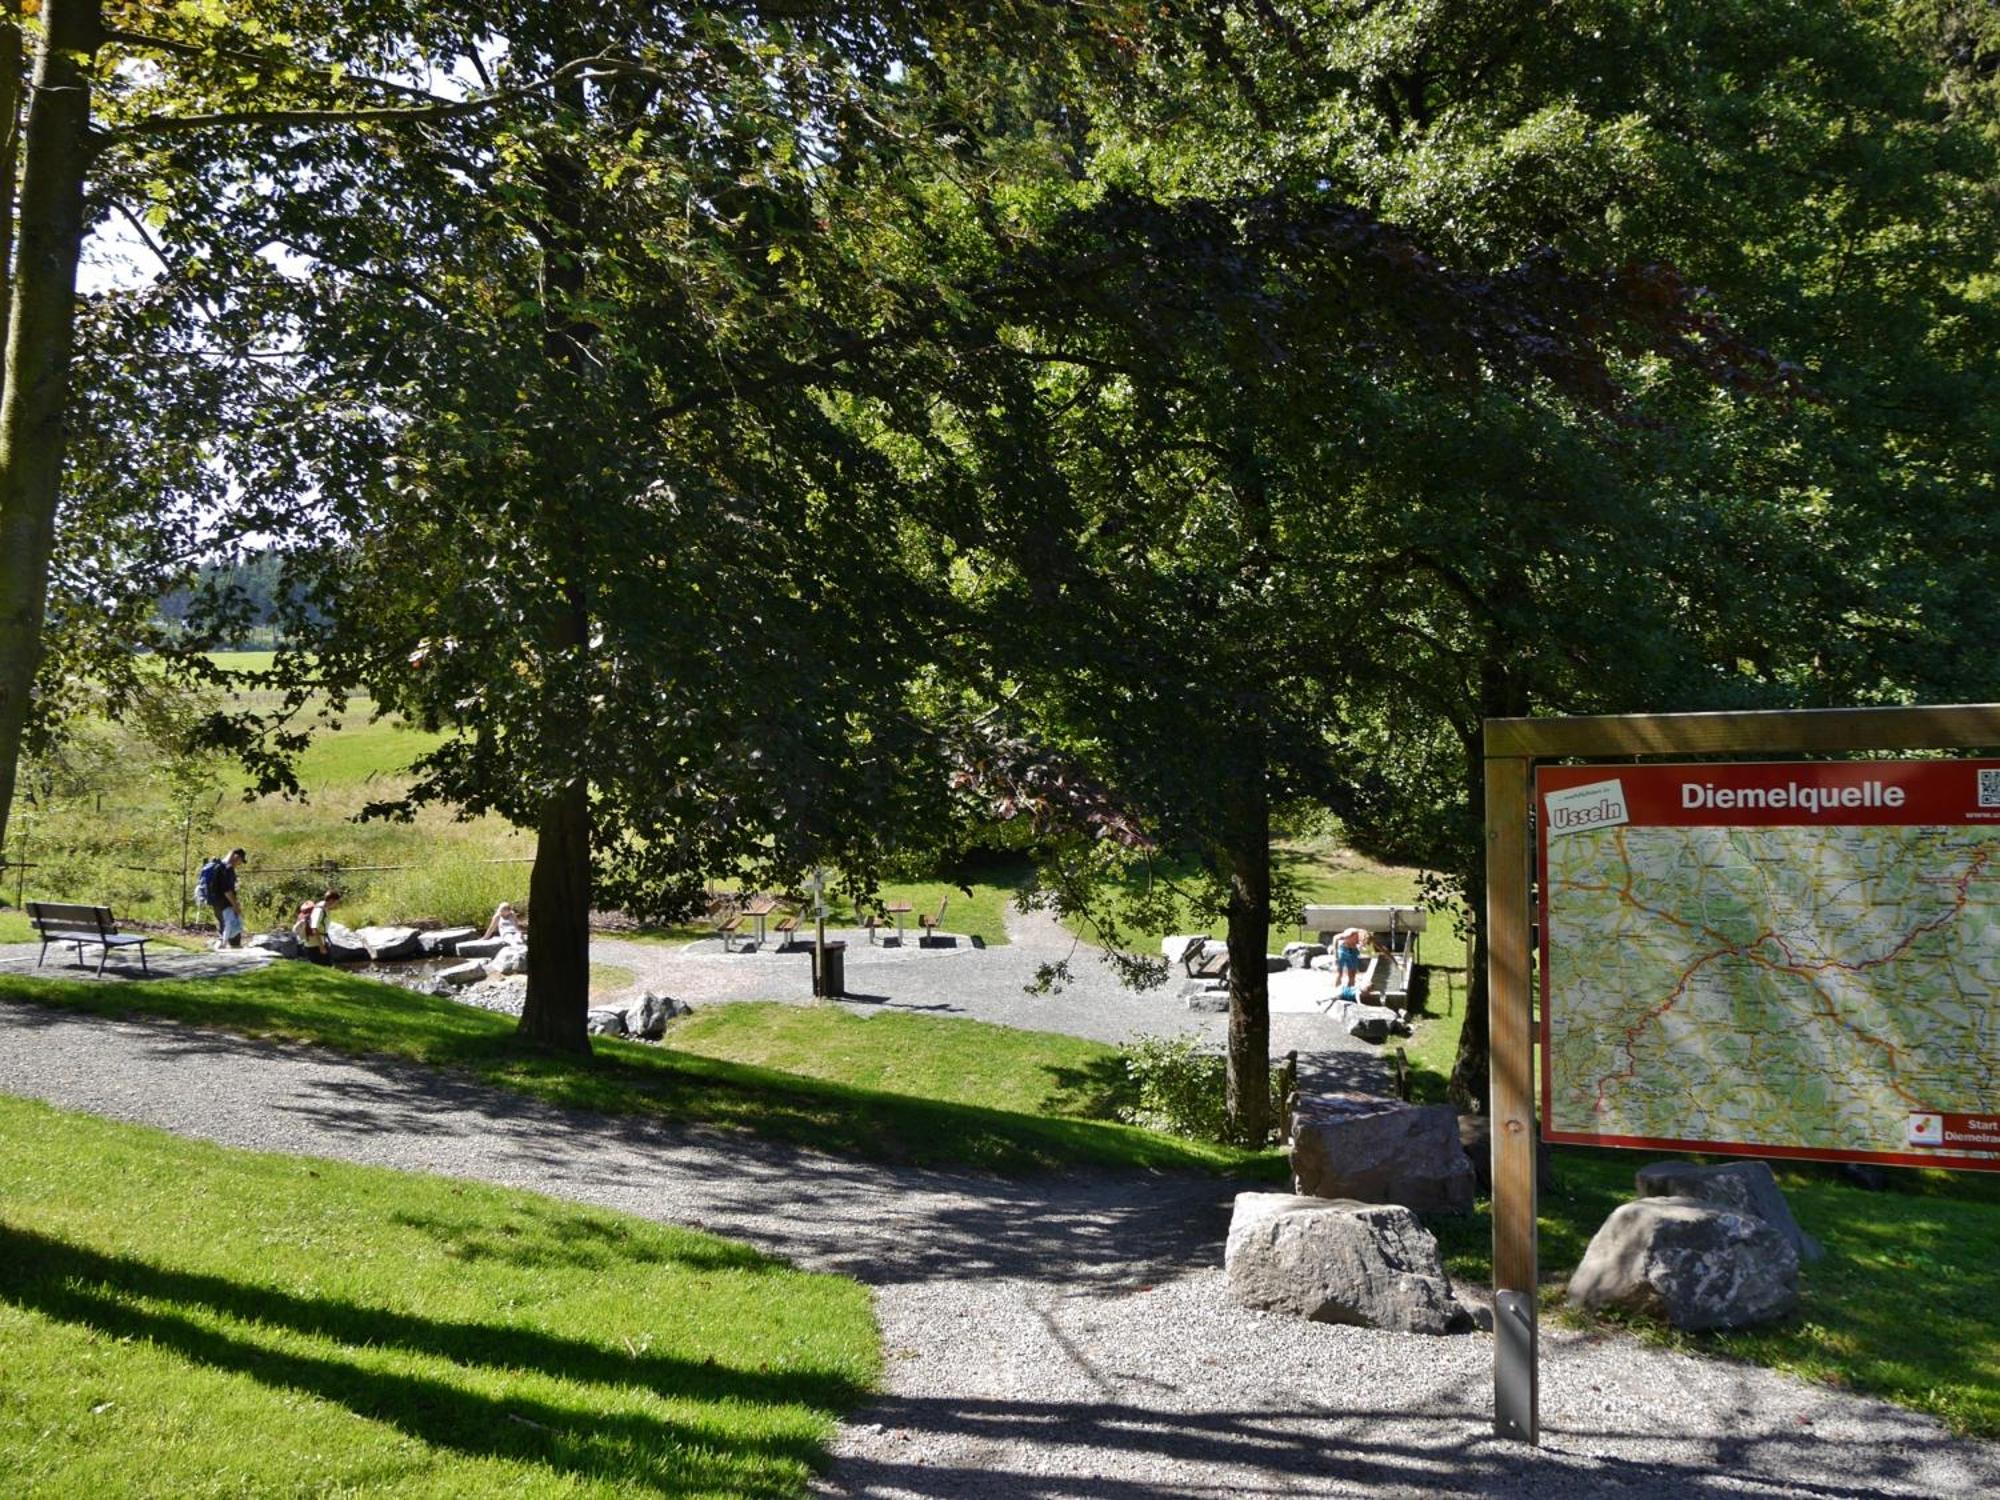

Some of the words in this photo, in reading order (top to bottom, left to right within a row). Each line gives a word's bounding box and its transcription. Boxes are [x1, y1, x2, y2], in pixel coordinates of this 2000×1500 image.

[1682, 781, 1905, 813] Diemelquelle
[1554, 799, 1621, 829] Usseln
[1968, 1120, 1998, 1130] Start
